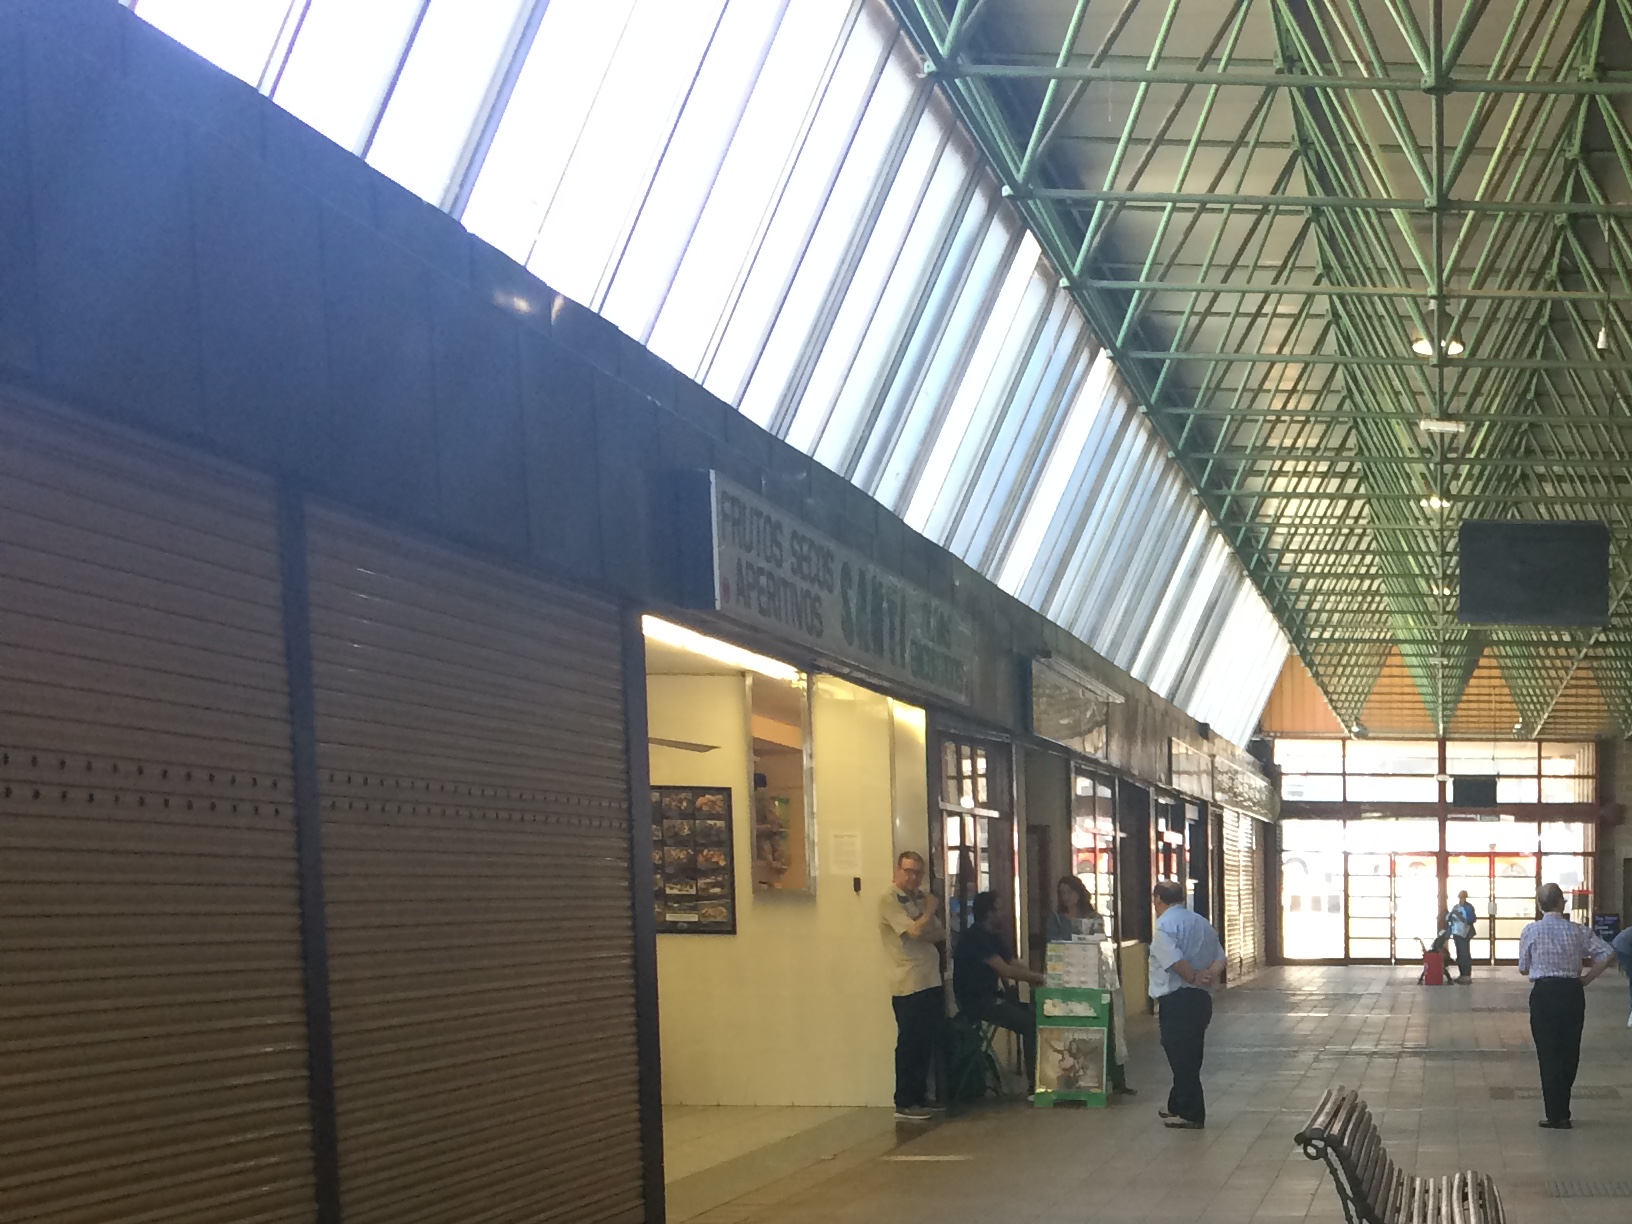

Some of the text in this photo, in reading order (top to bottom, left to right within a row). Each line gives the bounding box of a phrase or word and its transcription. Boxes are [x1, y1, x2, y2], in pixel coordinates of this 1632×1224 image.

[720, 489, 835, 595] FRUTOS SECOS
[735, 556, 824, 639] APERITIVOS
